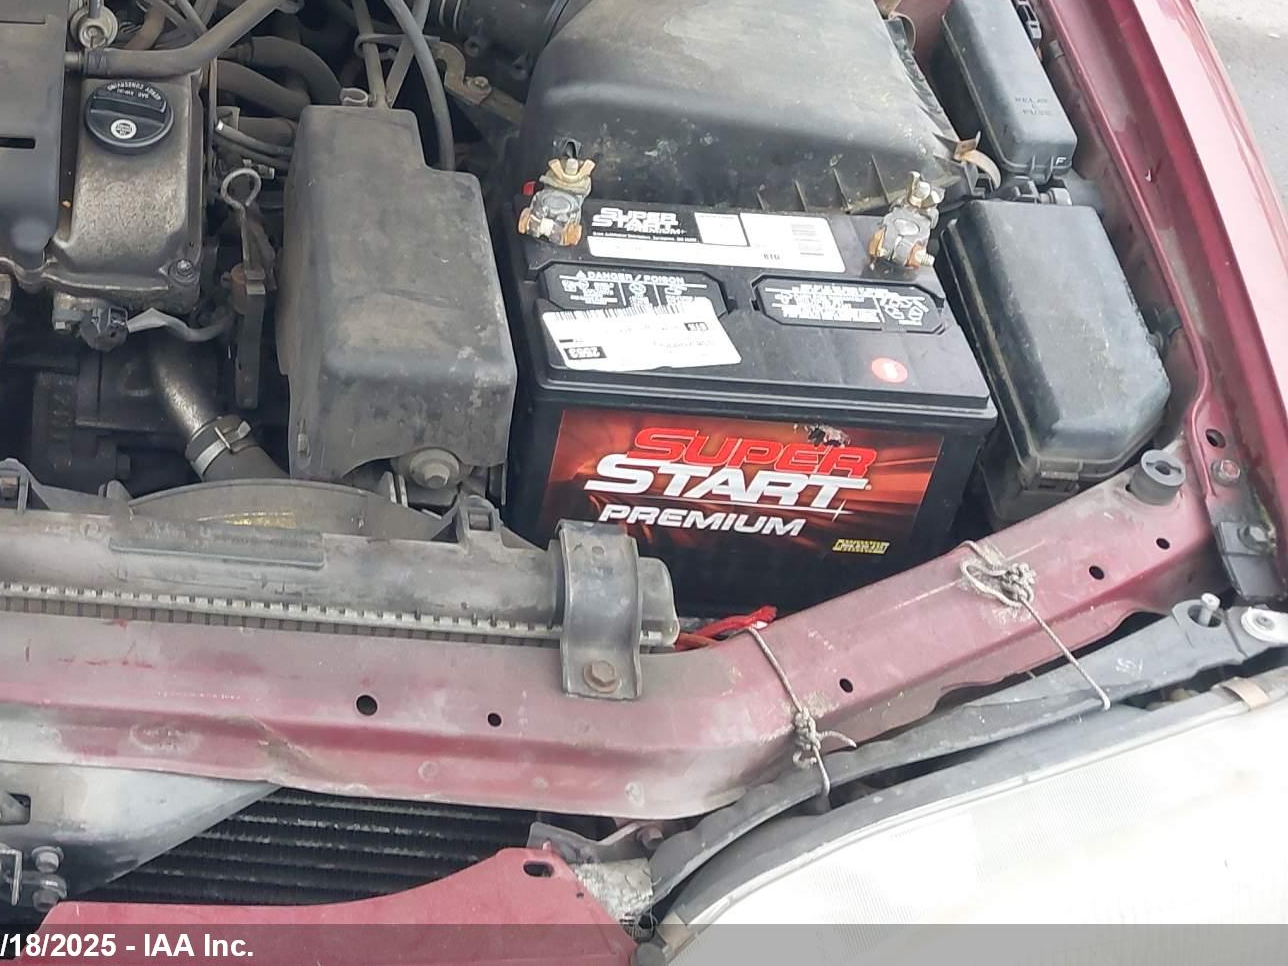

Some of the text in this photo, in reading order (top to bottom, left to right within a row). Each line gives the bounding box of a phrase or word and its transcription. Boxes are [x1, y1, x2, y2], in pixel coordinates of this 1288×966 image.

[592, 214, 679, 231] START
[599, 207, 678, 224] SUPER
[587, 271, 633, 283] DANGER
[643, 274, 685, 286] POISON
[626, 427, 878, 478] SUPER
[584, 453, 870, 509] START
[598, 504, 807, 537] PREMIUM
